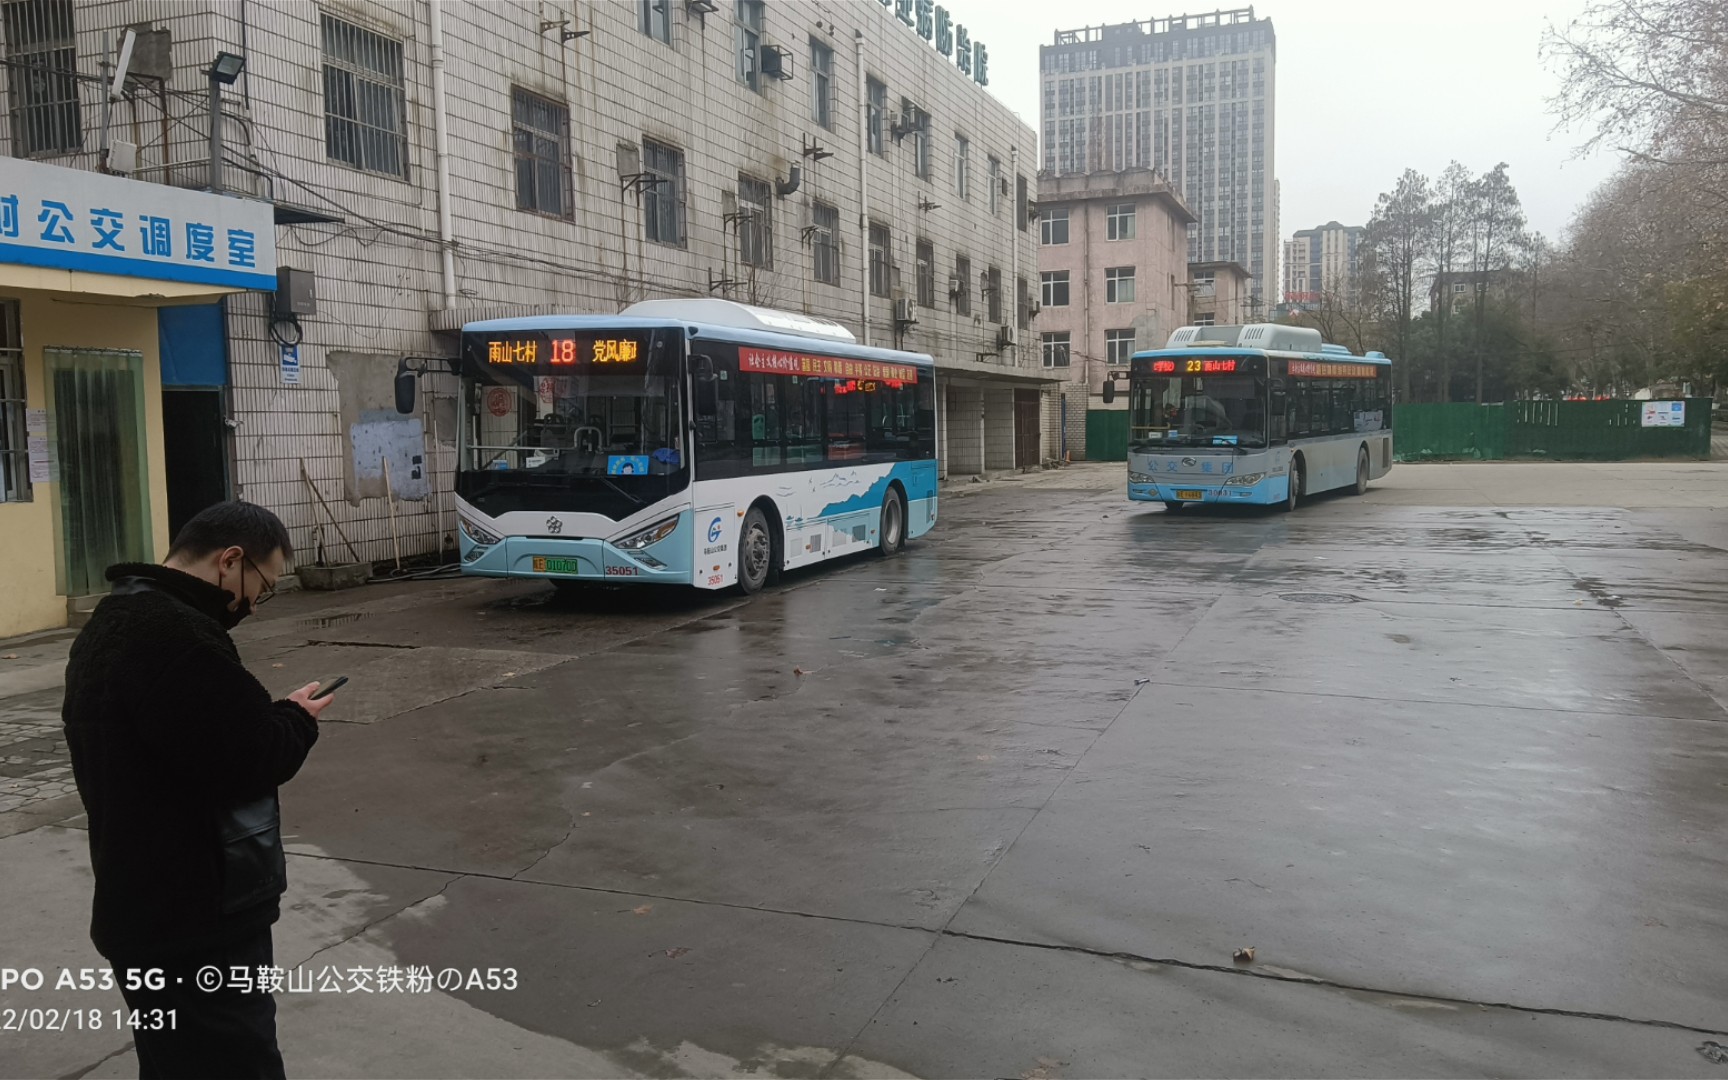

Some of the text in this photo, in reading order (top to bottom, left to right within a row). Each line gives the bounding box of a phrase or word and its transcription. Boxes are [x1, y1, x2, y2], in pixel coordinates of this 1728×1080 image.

[488, 340, 537, 363] 雨山七村
[551, 340, 576, 362] 18
[1187, 360, 1202, 371] 23
[605, 566, 639, 576] 35051
